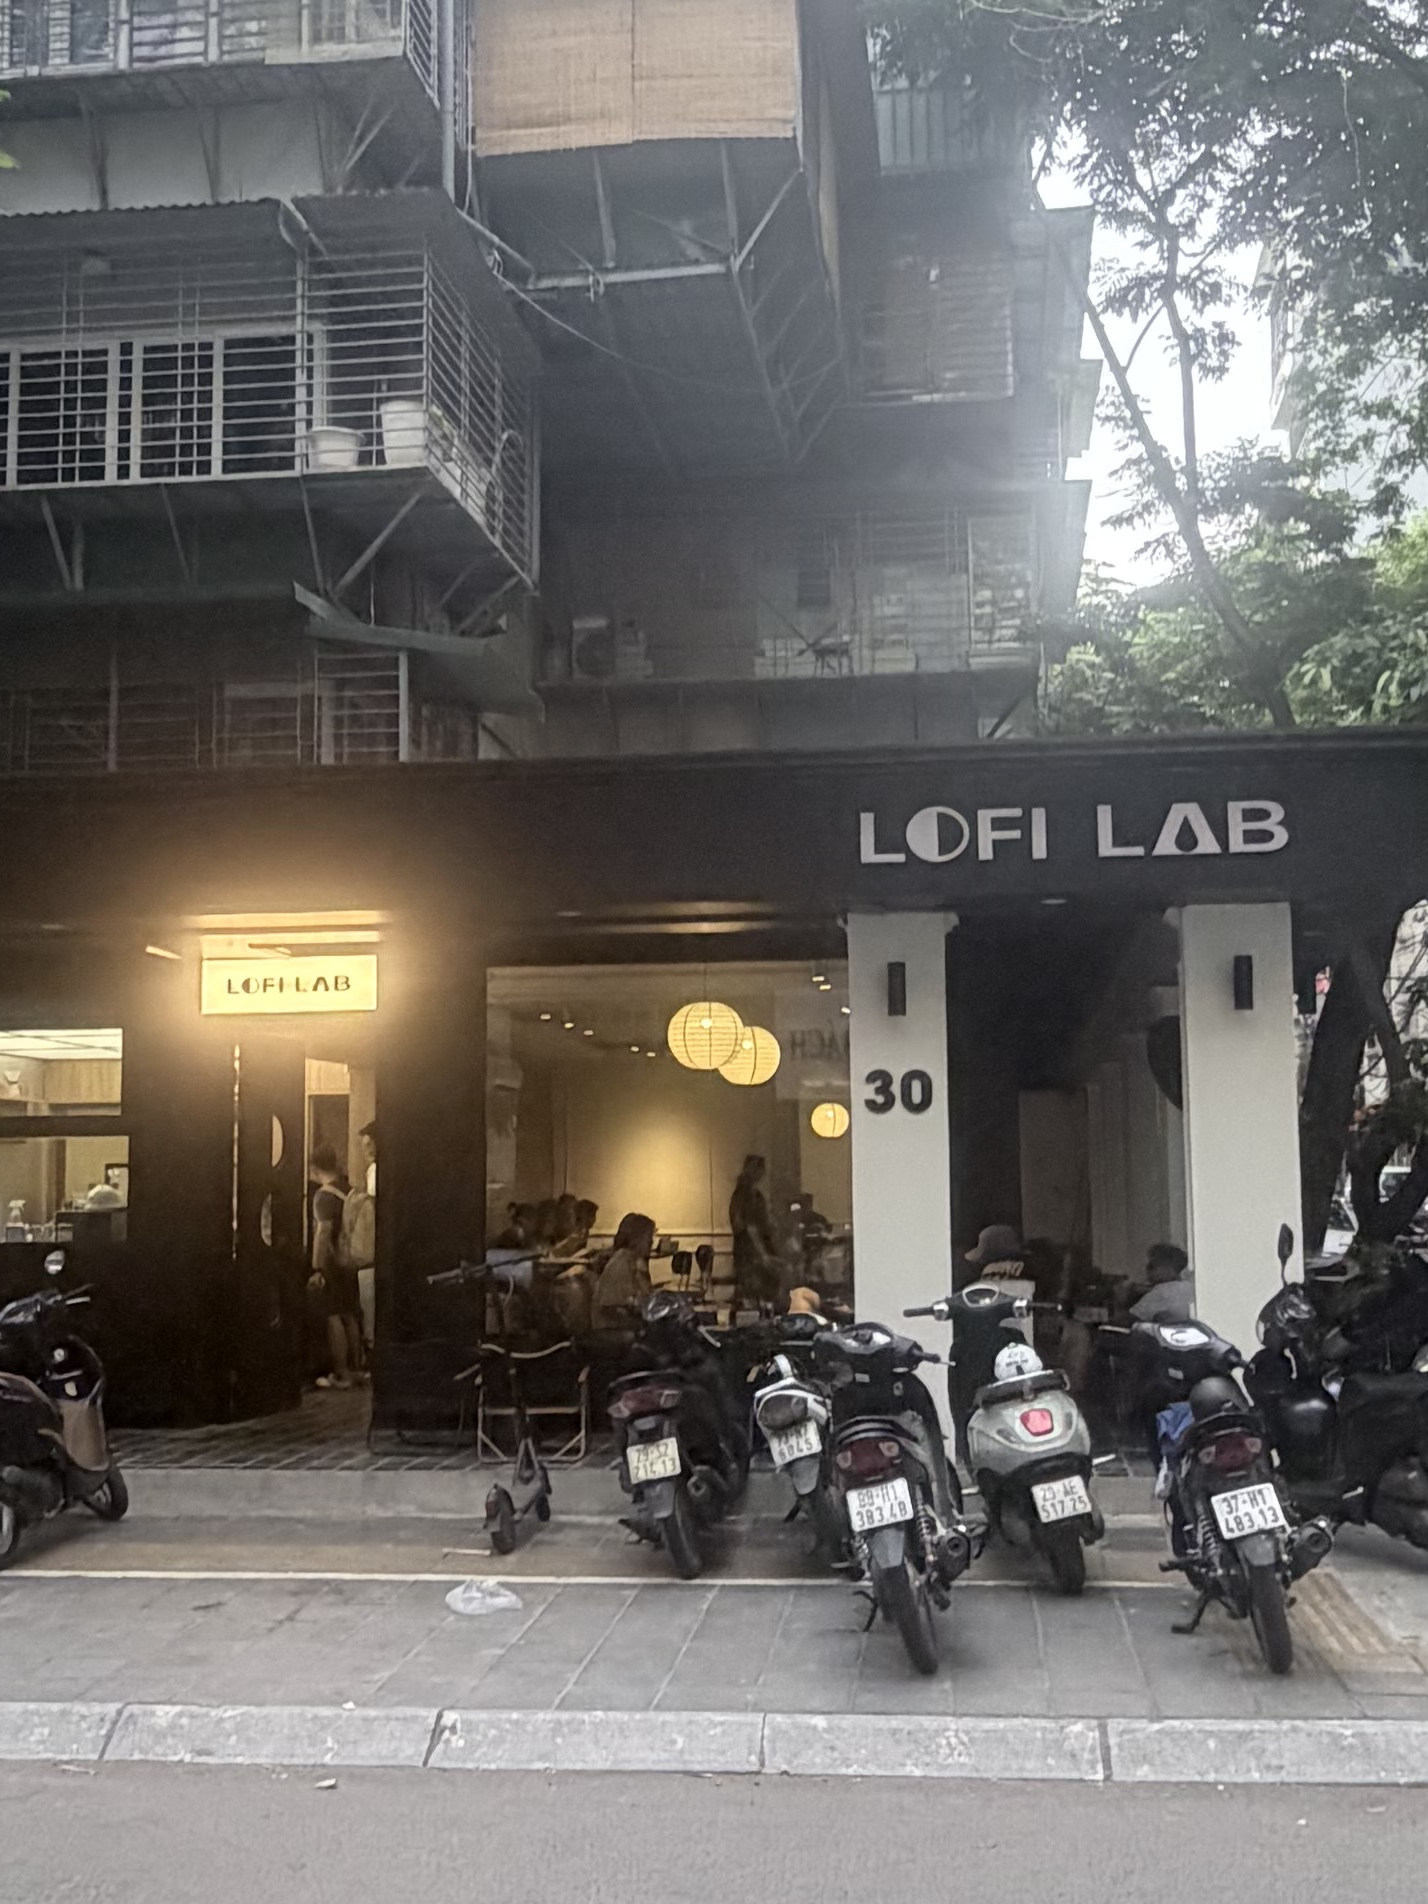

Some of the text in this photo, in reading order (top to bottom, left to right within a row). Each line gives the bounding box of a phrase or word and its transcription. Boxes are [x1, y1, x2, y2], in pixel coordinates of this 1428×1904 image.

[860, 800, 1289, 863] LOFI LAB
[227, 975, 351, 994] LOFI LAB
[864, 1069, 933, 1115] 30
